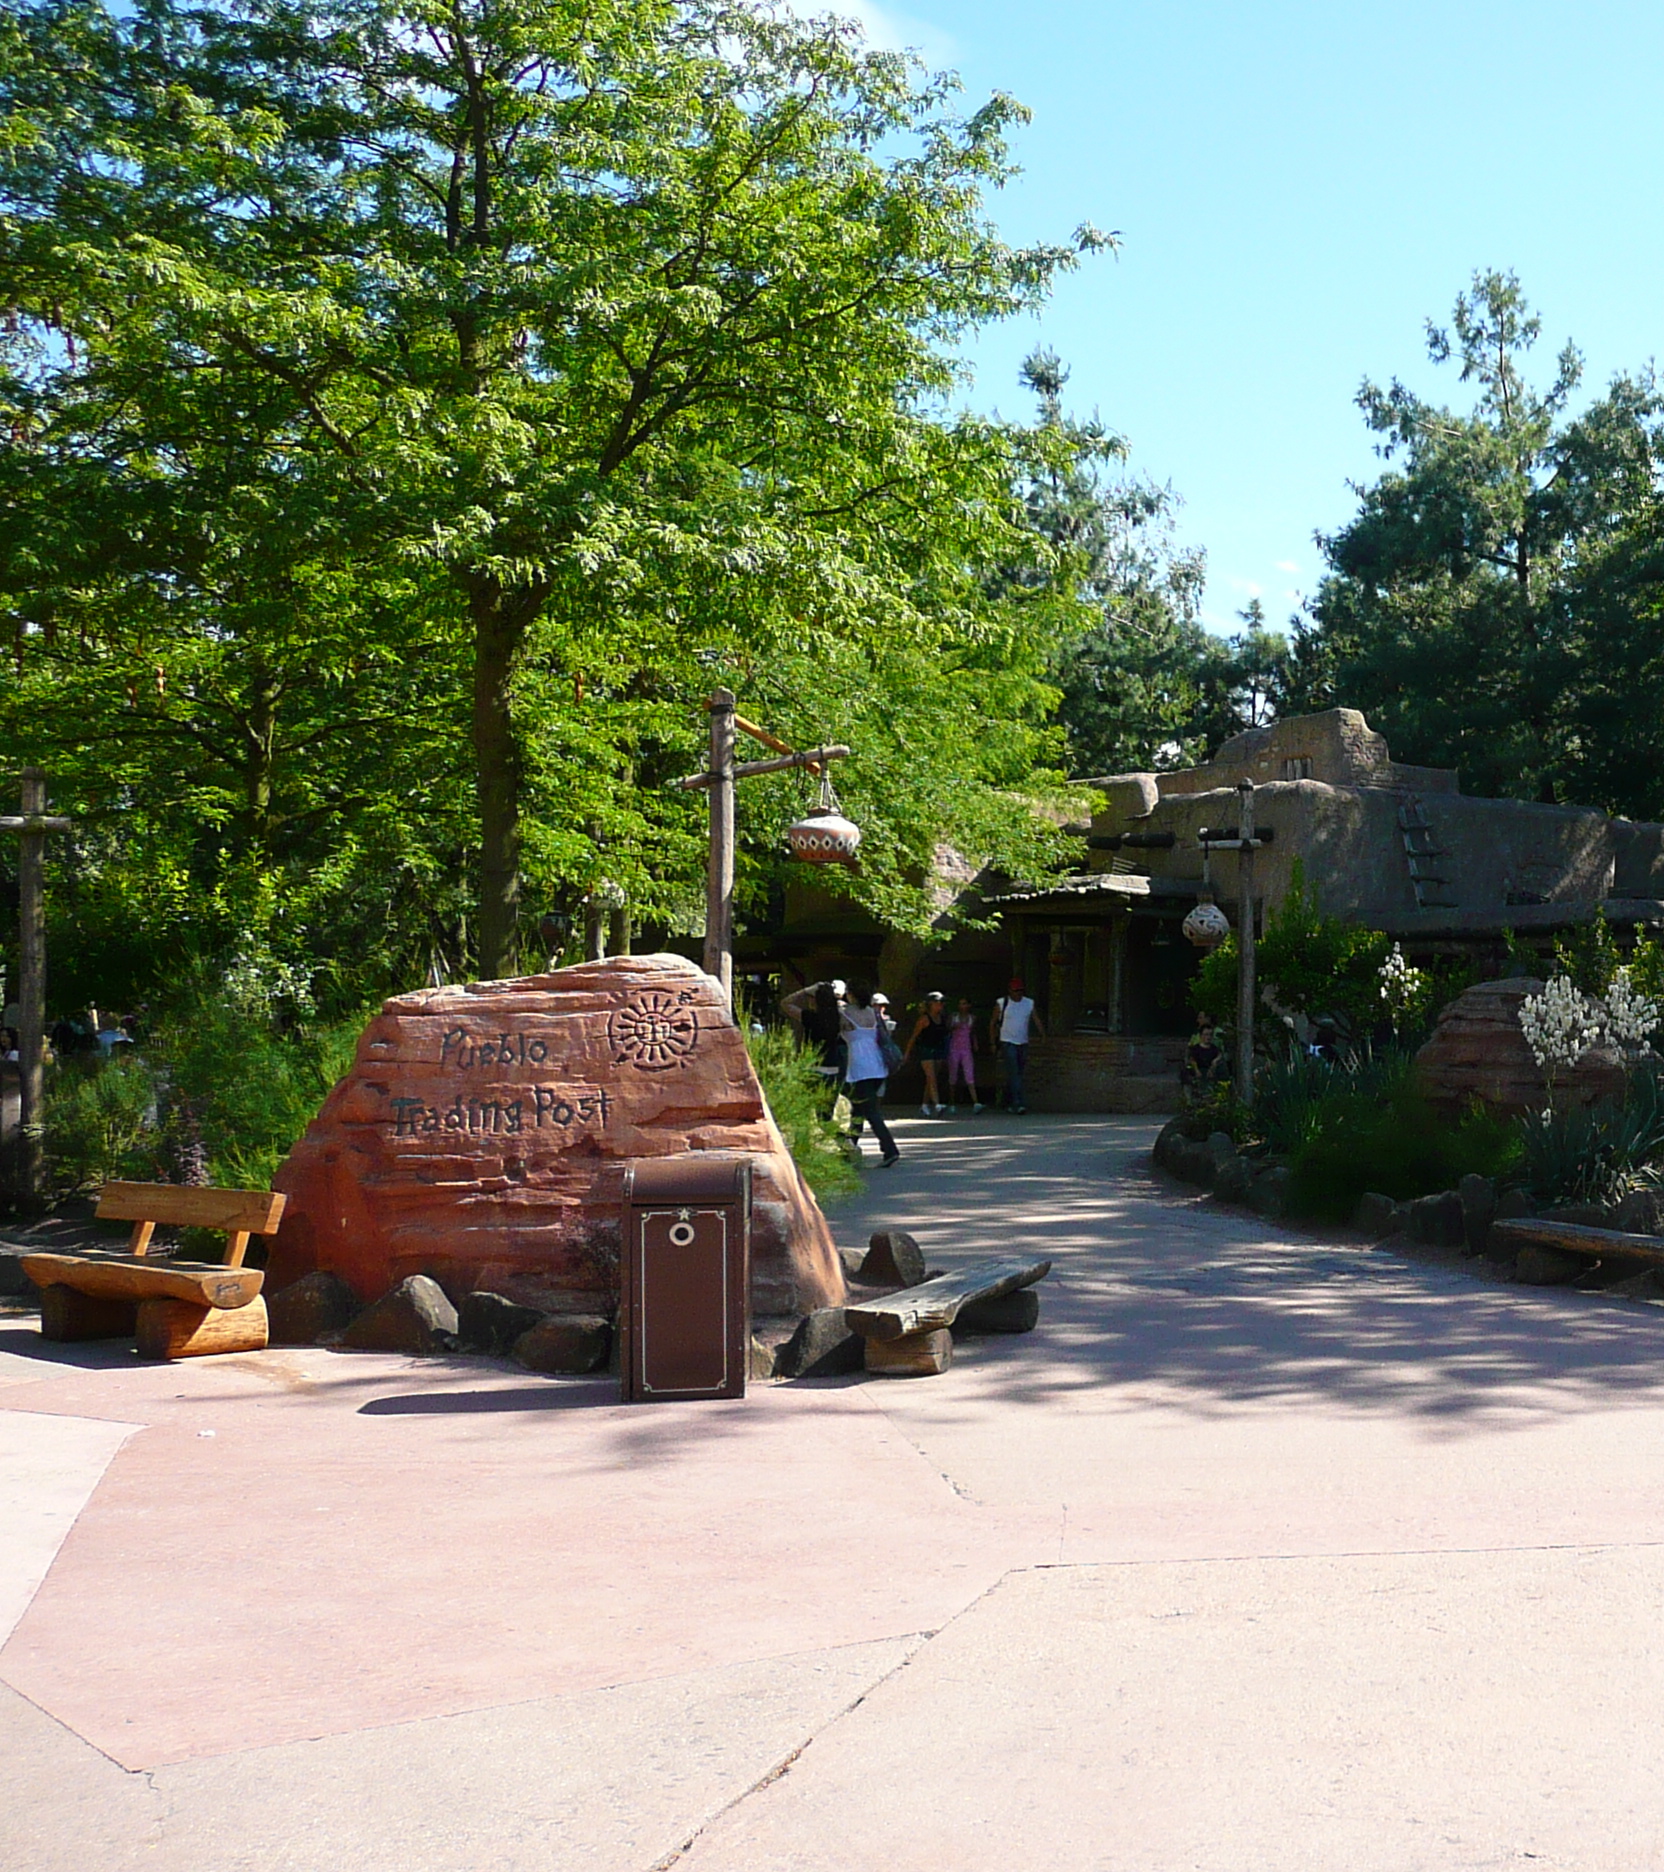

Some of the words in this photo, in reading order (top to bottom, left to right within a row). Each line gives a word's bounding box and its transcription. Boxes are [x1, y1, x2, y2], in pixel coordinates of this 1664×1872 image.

[442, 1027, 548, 1069] Pueblo
[390, 1096, 523, 1135] Trading
[534, 1084, 613, 1128] Post
